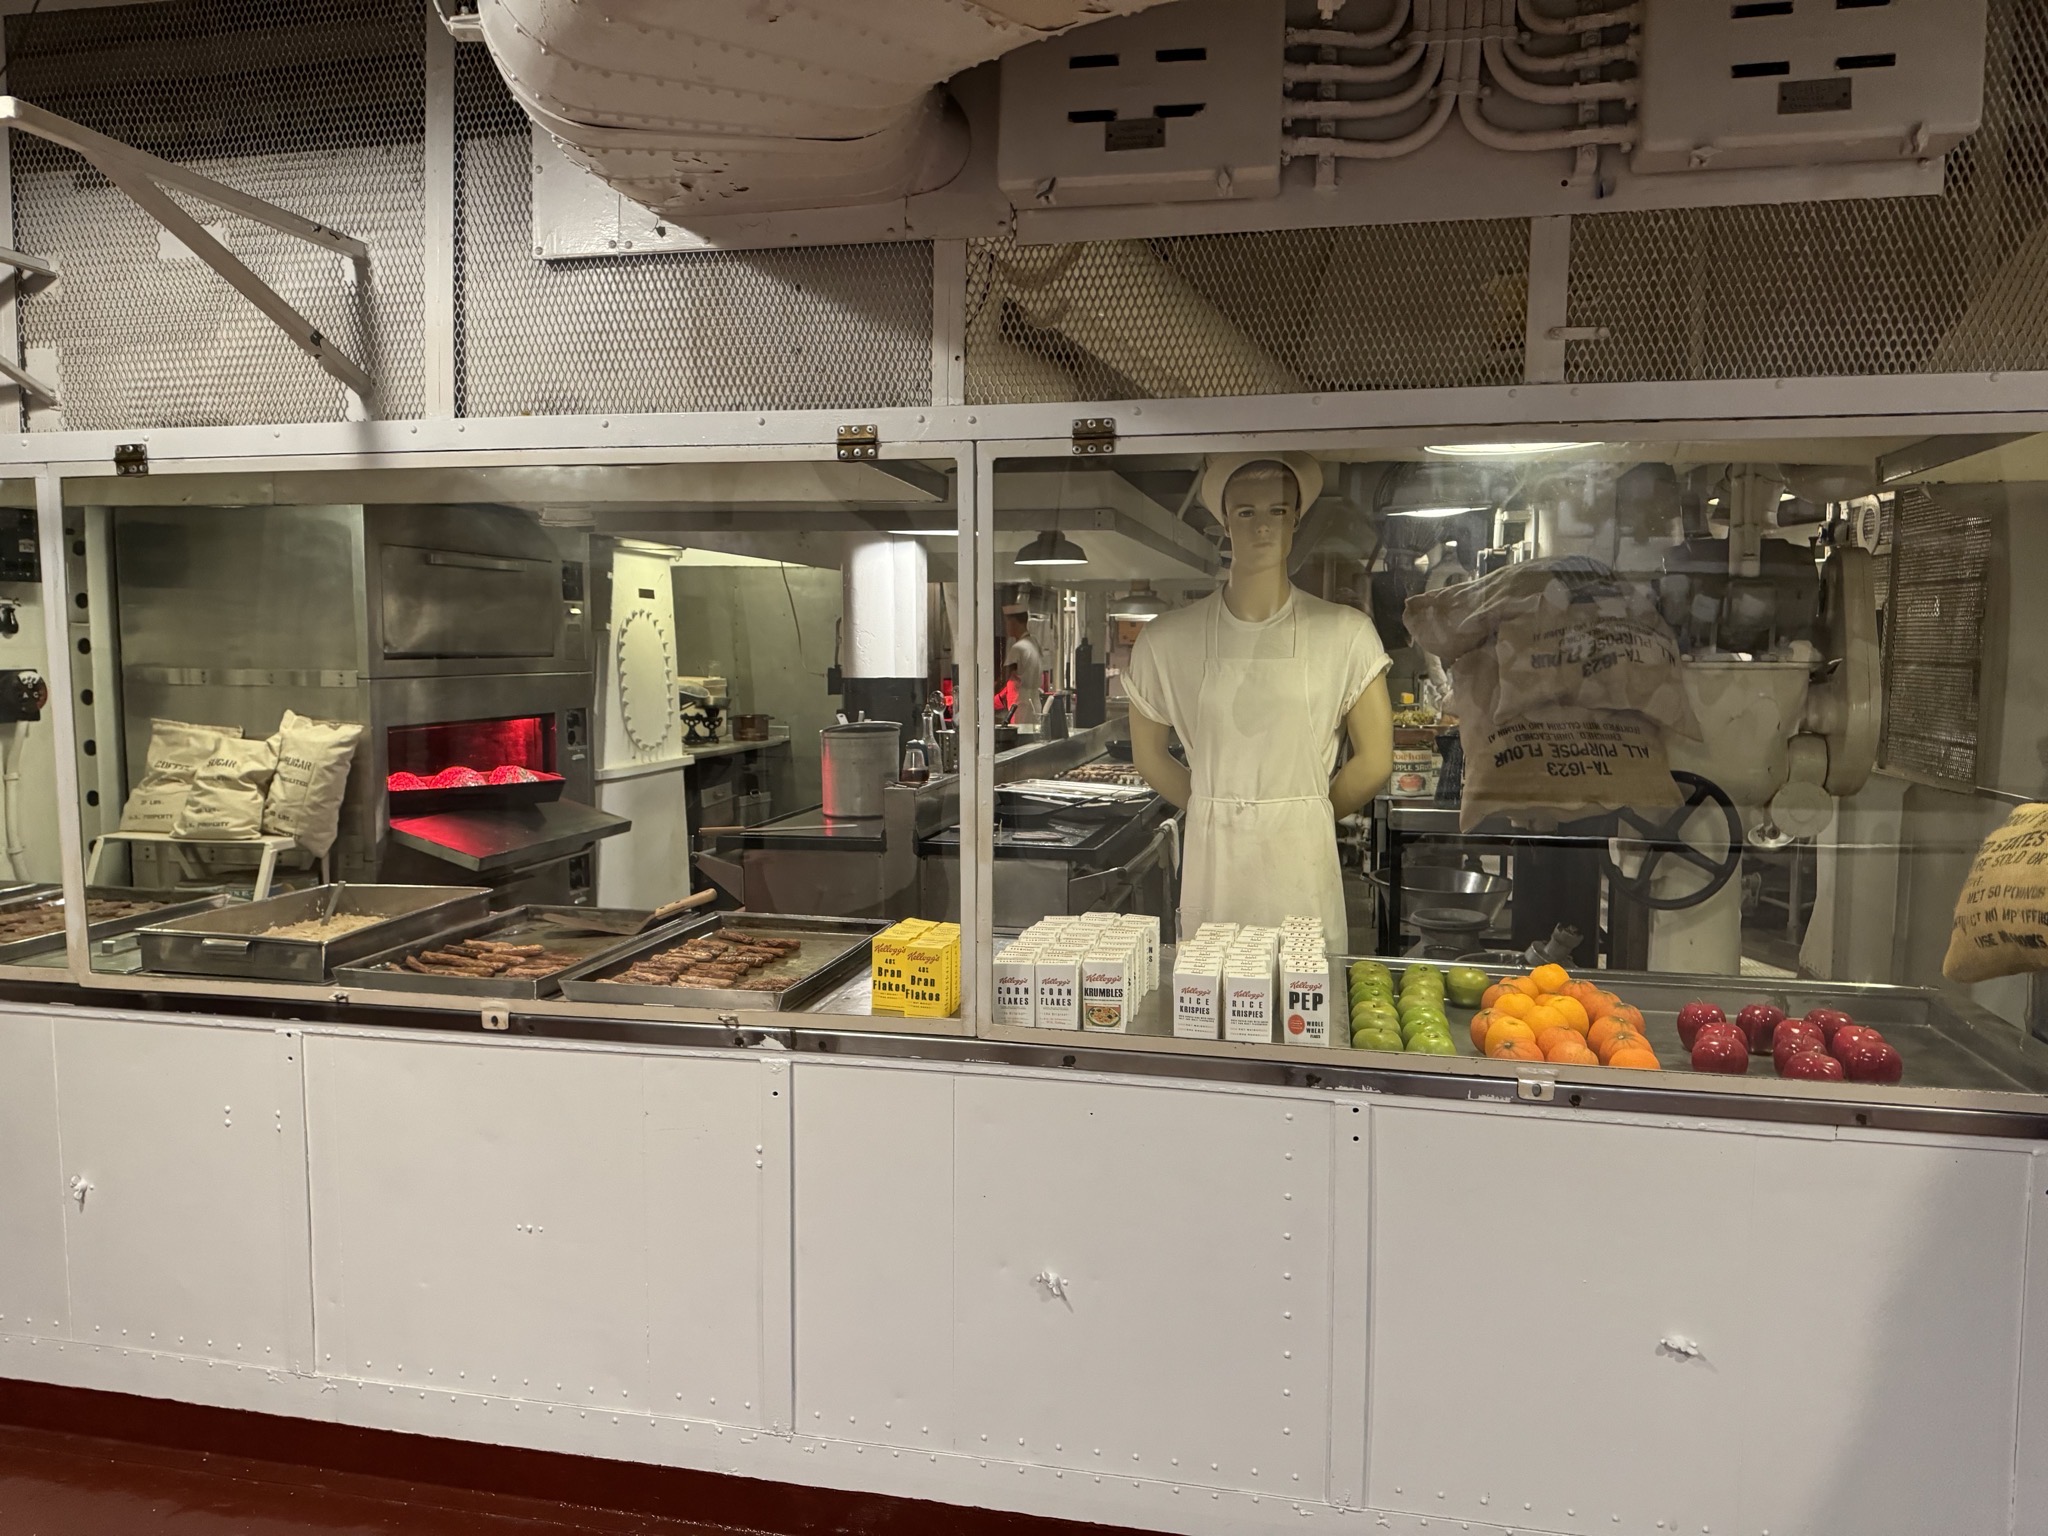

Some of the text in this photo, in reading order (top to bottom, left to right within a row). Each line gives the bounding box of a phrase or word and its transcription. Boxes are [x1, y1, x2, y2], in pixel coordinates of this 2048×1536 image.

[1494, 742, 1649, 768] ALL PURPOSE FLOUR
[206, 757, 237, 769] SUGAR
[874, 943, 906, 956] Kellogg's
[907, 951, 941, 964] Kellogg's
[877, 966, 902, 978] Bran
[910, 975, 935, 987] Bran
[998, 976, 1029, 986] Kellogg's
[1041, 977, 1071, 987] Kellogg's
[1084, 973, 1122, 984] Kellogg's
[873, 979, 906, 992] Flakes
[998, 986, 1029, 995] CORN
[1289, 980, 1323, 991] Kellogg's
[905, 988, 940, 1001] Flakes
[1040, 987, 1072, 996] CORN
[1084, 987, 1124, 998] KRUMBLES
[1180, 986, 1212, 997] Kellogg's
[1233, 990, 1265, 1000] Kellogg's
[998, 996, 1029, 1006] FLAKES
[1040, 997, 1072, 1007] FLAKES
[1180, 996, 1210, 1006] RICE
[1232, 1000, 1263, 1009] RICE
[1289, 991, 1324, 1012] PEP
[1179, 1005, 1210, 1015] KRISPIES
[1232, 1009, 1264, 1019] KRISPIES
